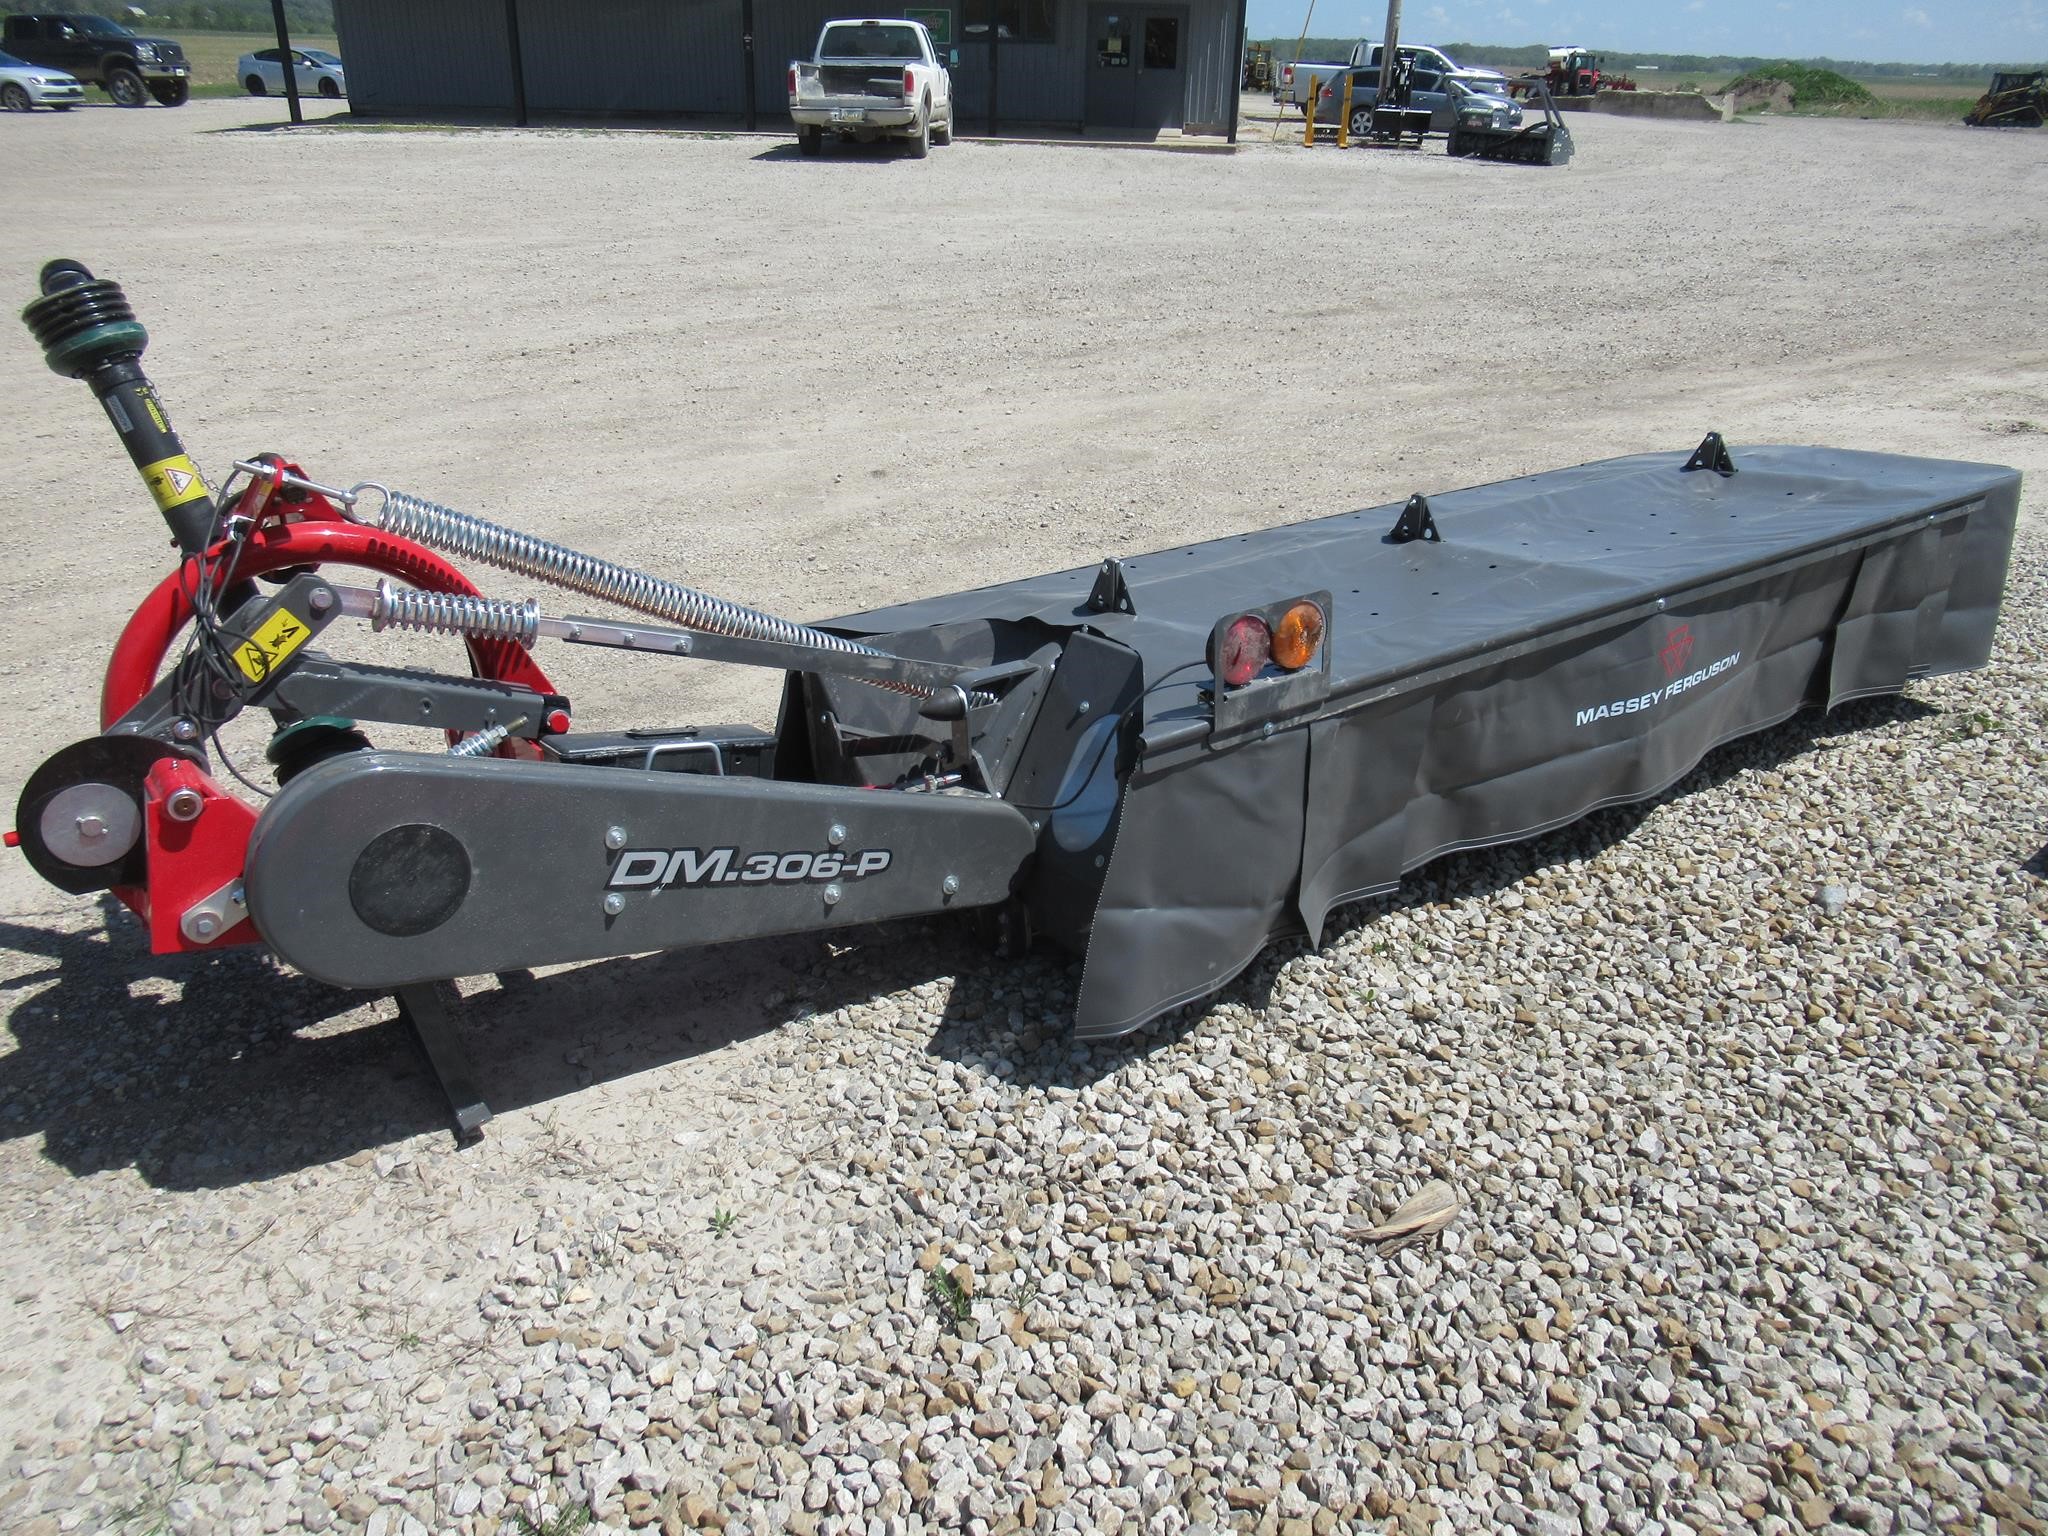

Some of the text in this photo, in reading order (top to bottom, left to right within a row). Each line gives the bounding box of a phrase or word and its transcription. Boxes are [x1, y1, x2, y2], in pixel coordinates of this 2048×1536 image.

[1576, 651, 1741, 727] MASSEY FERGUSON
[609, 849, 891, 886] DM.306-P
